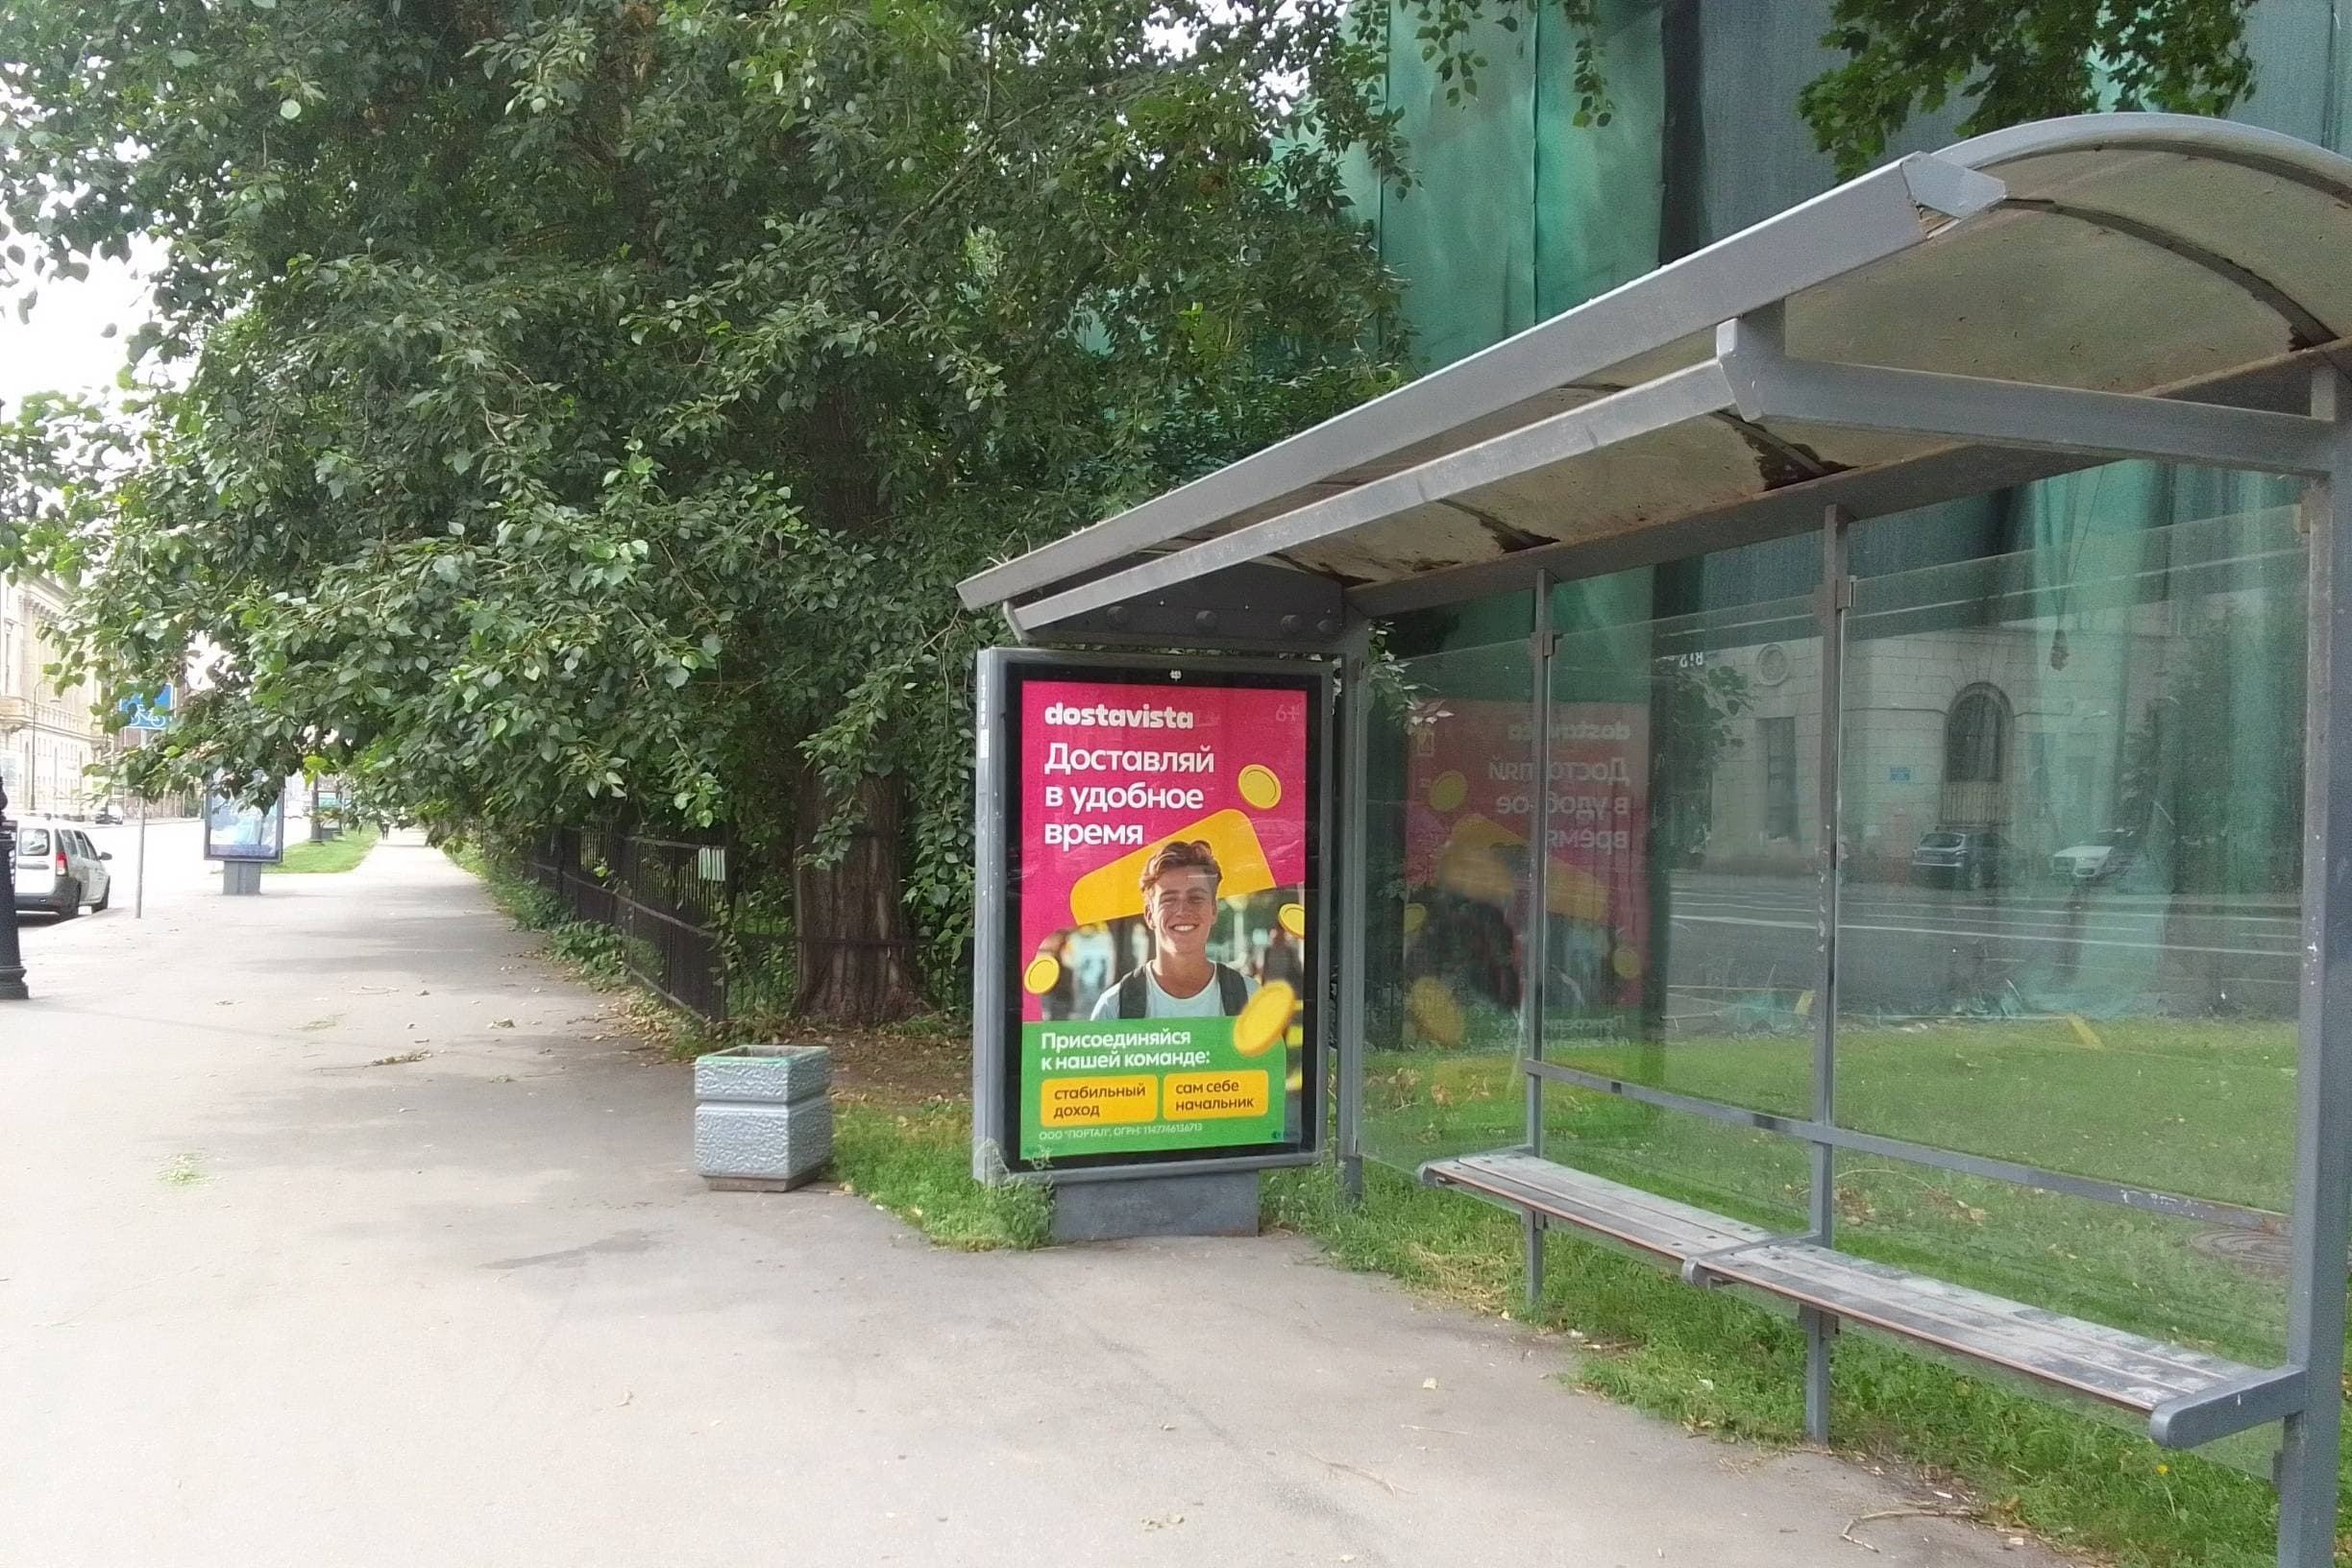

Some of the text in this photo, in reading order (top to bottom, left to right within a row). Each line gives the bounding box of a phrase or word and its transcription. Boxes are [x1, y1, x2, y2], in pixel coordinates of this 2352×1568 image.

[1044, 702, 1194, 729] dostavista
[1044, 742, 1214, 774] Доставляй
[1044, 781, 1205, 815] в удобное
[1044, 822, 1143, 852] время
[1041, 1027, 1191, 1053] Присоединяйся
[1041, 1049, 1212, 1071] к нашей команде:
[1054, 1083, 1146, 1101] стабильный
[1175, 1079, 1239, 1095] сам себе
[1053, 1104, 1100, 1119] доход
[1175, 1097, 1255, 1112] начальник
[1039, 1130, 1063, 1140] ООО
